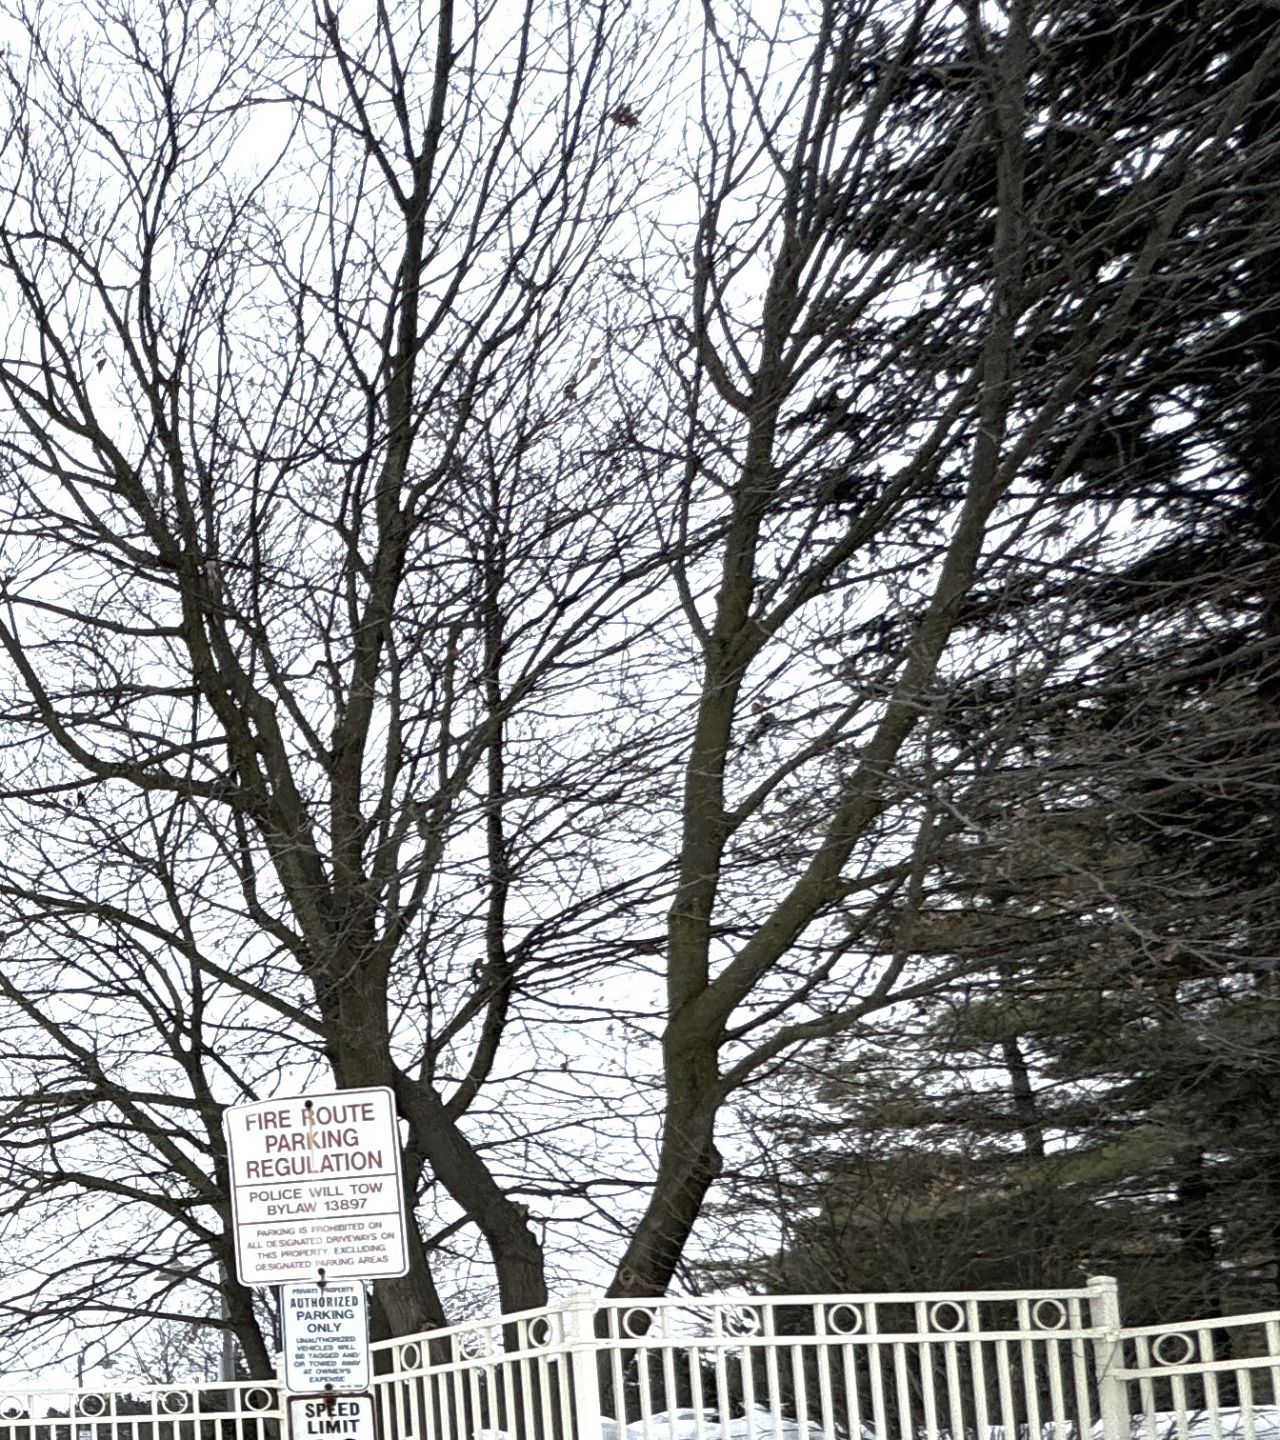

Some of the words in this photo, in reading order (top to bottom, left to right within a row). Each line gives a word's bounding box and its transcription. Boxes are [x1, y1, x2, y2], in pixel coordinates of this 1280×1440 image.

[245, 1110, 291, 1131] FIRE
[302, 1103, 375, 1126] ROUTE
[265, 1128, 359, 1153] PARKING
[246, 1151, 383, 1178] REGULATION
[249, 1188, 302, 1202] POLICE
[309, 1186, 344, 1198] WILL
[349, 1182, 383, 1195] TOW
[267, 1201, 317, 1216] BYLAW
[324, 1198, 368, 1212] 13897
[257, 1227, 295, 1237] PARKING
[299, 1226, 307, 1234] IS
[311, 1222, 365, 1232] PROHIBITED
[368, 1221, 382, 1229] ON
[266, 1237, 322, 1248] DESIGNATED
[326, 1233, 377, 1244] DRIVEWAYS
[381, 1232, 395, 1240] ON
[258, 1251, 277, 1259] THIS
[334, 1244, 386, 1255] EXCLUDING
[255, 1261, 311, 1271] DESIGNATED
[316, 1257, 354, 1266] PARKING
[358, 1255, 389, 1264] AREAS
[290, 1296, 359, 1308] AUTHORIZED
[296, 1309, 354, 1320] PARKING
[307, 1322, 342, 1333] ONLY
[305, 1402, 360, 1418] SPEED
[307, 1419, 360, 1435] LIMIT
